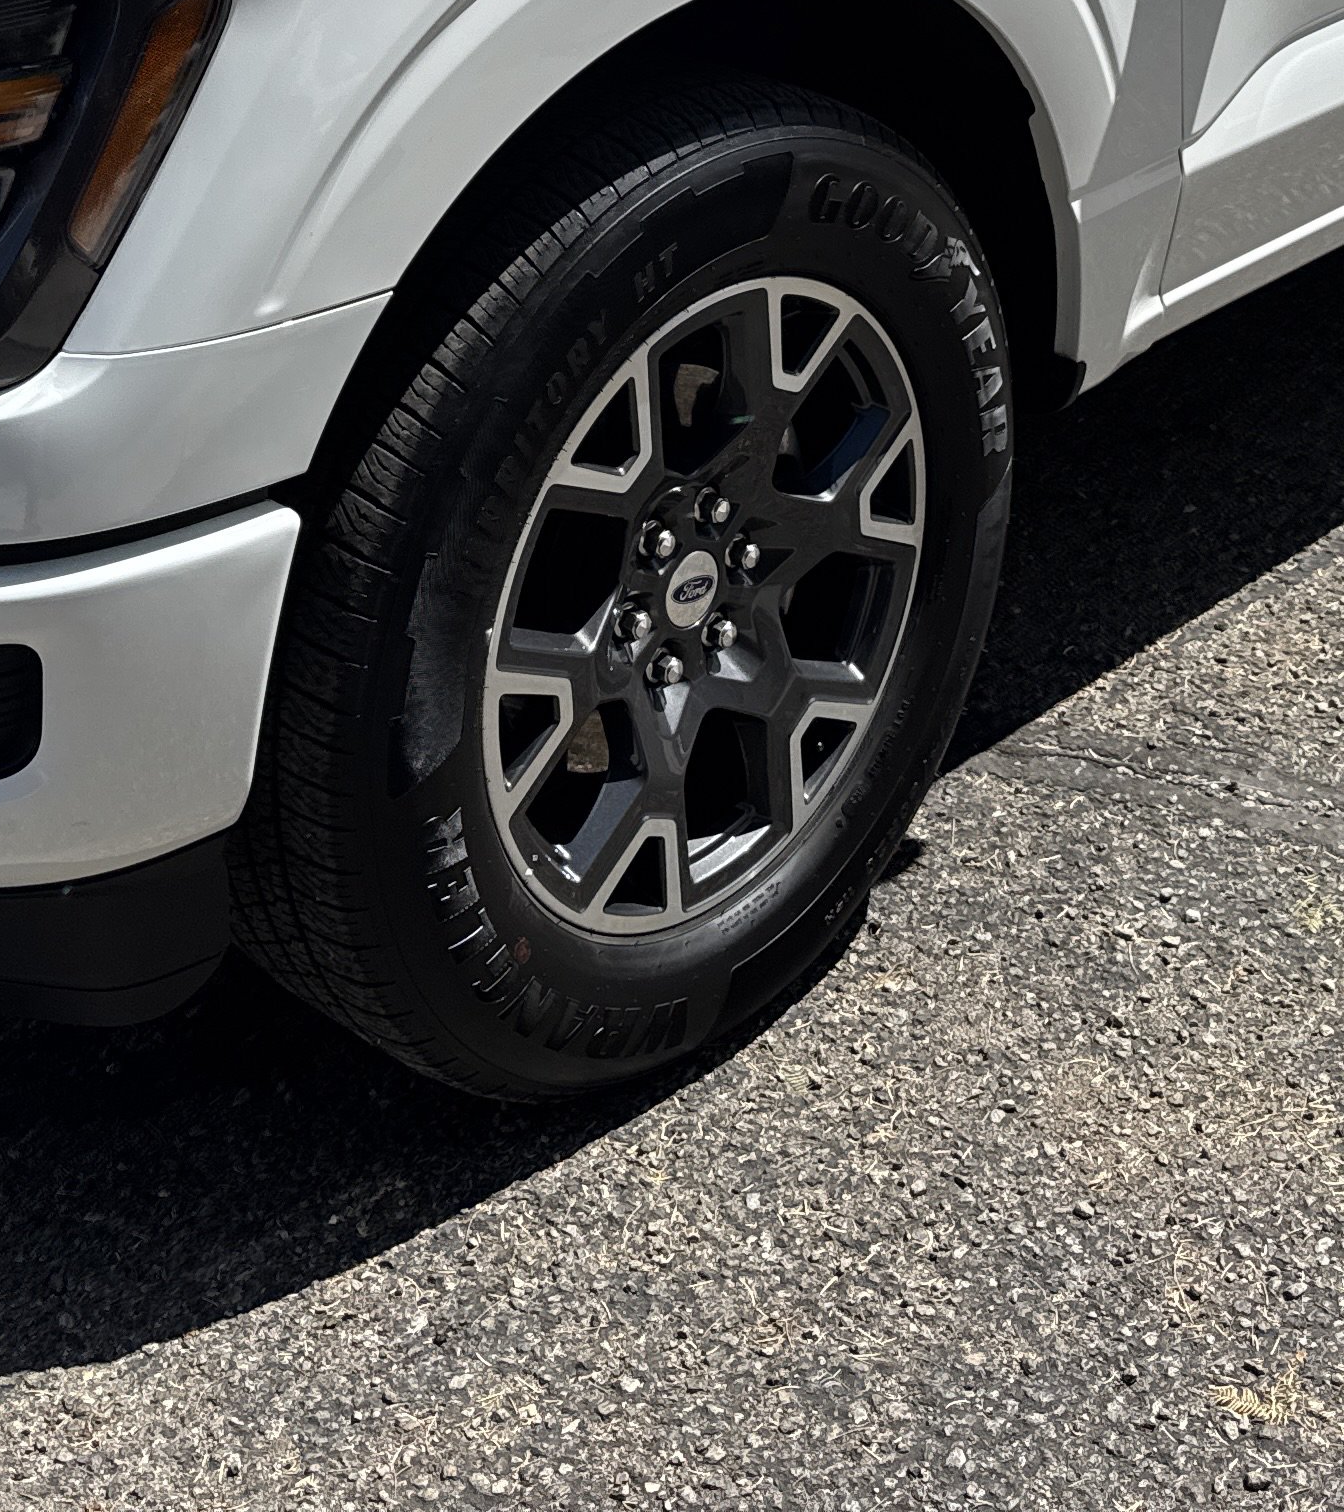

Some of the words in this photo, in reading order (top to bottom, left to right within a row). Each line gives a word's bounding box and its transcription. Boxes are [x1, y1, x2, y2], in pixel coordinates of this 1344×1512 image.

[808, 172, 1007, 457] GOODYEAR
[679, 579, 709, 601] Ford
[422, 805, 689, 1059] WRANGLER
